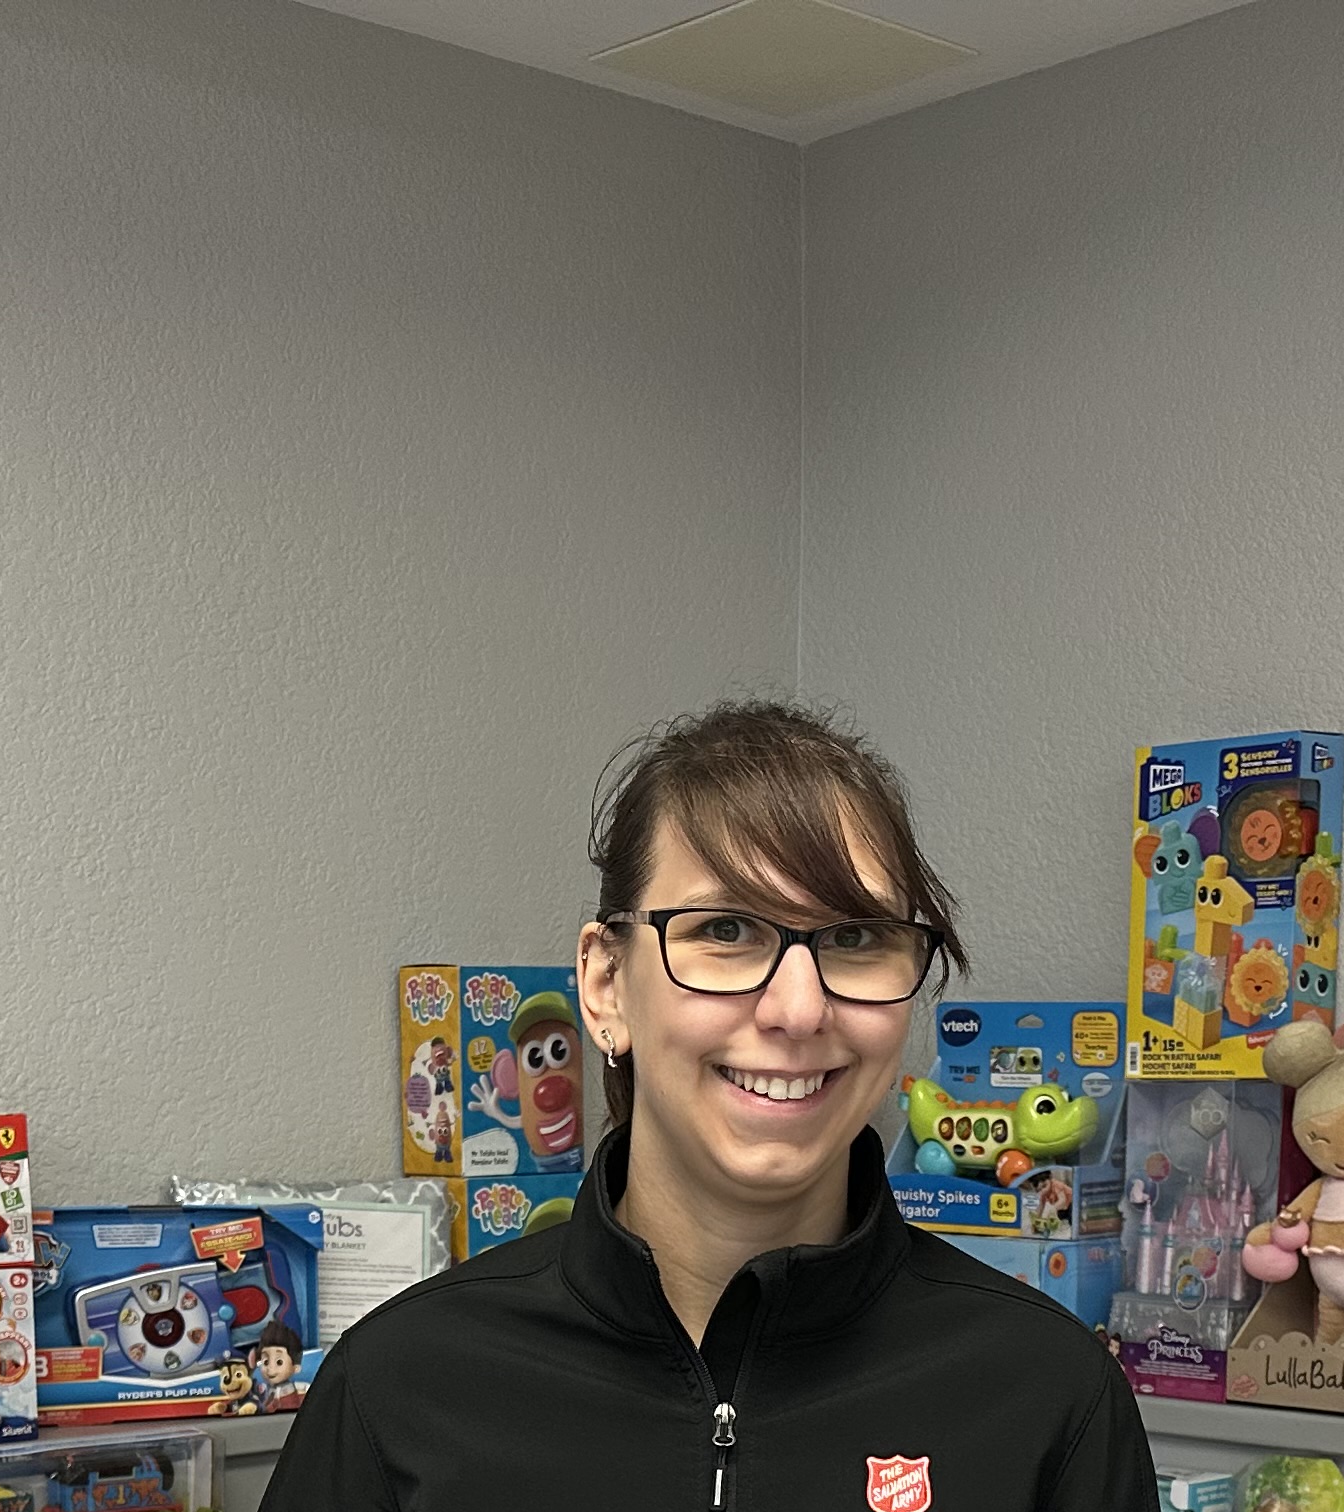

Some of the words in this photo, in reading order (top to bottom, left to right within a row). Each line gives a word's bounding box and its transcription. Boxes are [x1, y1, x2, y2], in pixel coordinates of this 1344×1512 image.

[1152, 767, 1183, 788] MEGA
[1223, 752, 1239, 780] 3
[1149, 783, 1202, 816] BLOKS
[942, 1019, 979, 1033] vtech
[1148, 1339, 1203, 1363] PRINCESS
[873, 1467, 924, 1503] SALVATION
[879, 1464, 904, 1481] THE
[891, 1485, 923, 1511] ARMY
